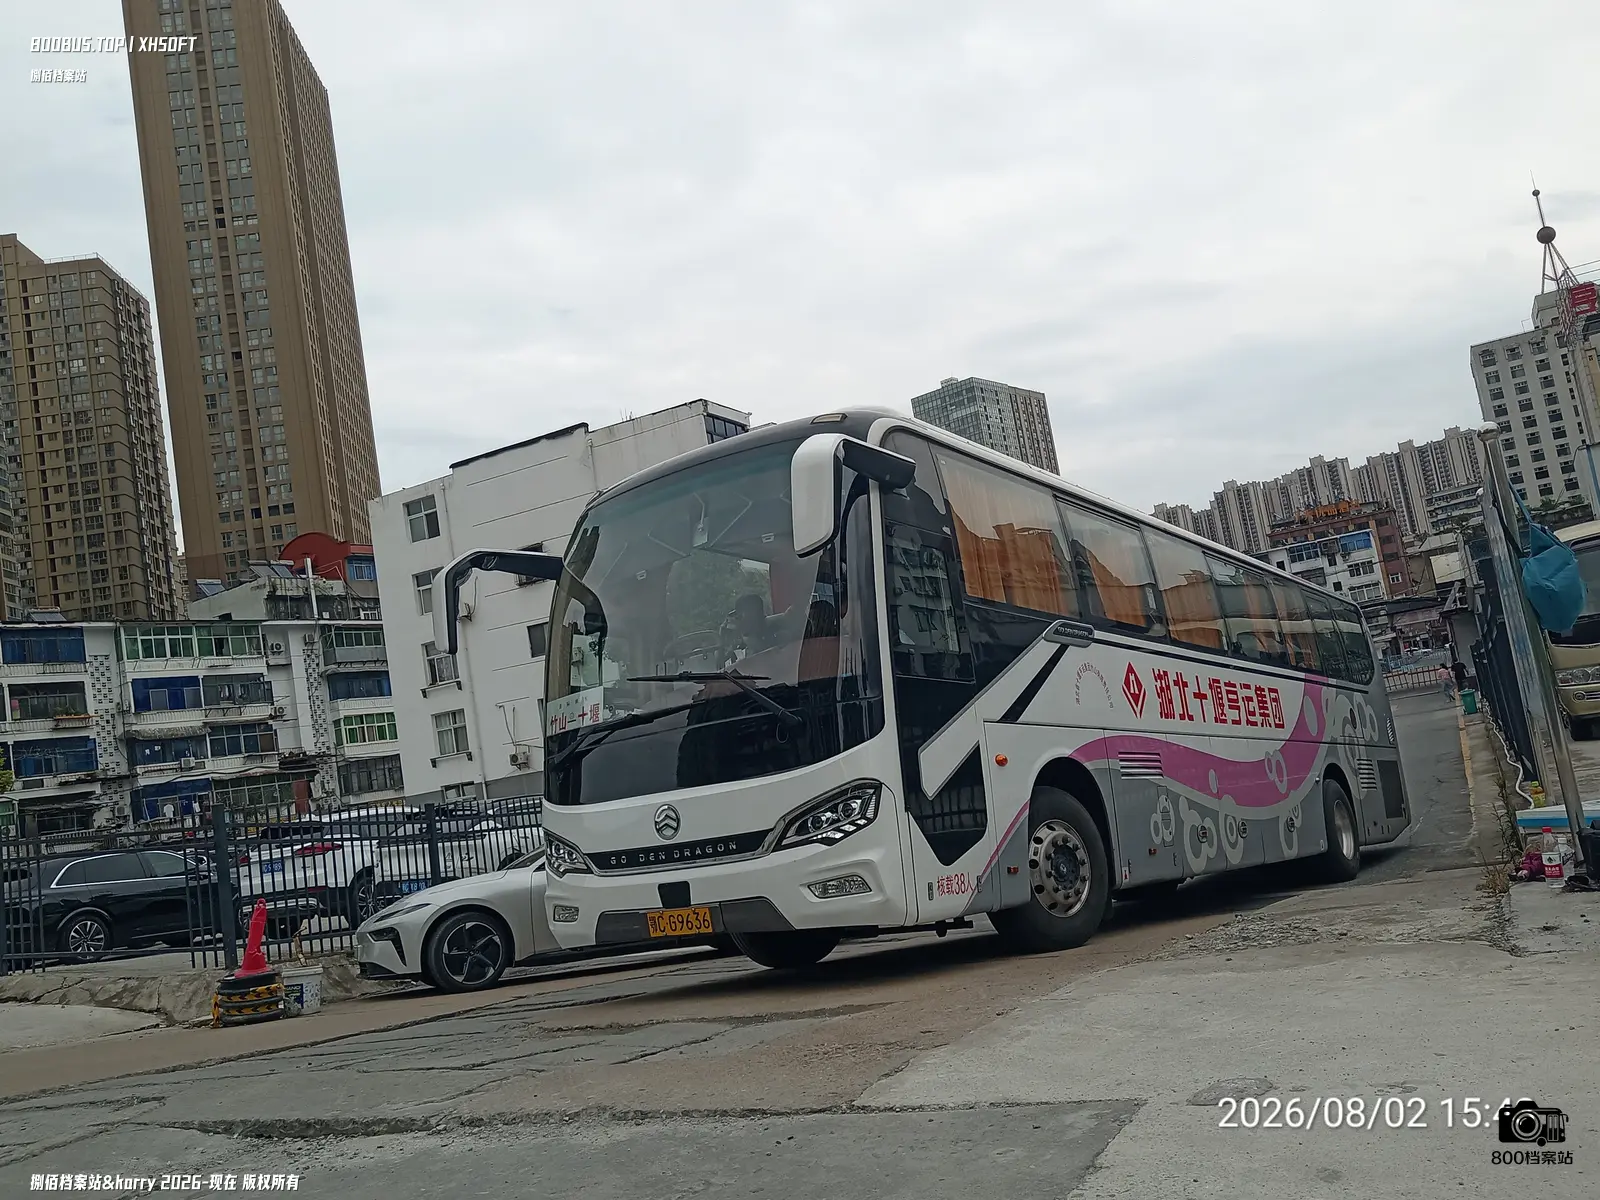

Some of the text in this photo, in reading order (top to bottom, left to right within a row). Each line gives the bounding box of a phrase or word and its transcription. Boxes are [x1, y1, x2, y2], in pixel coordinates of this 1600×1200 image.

[1151, 667, 1285, 729] 湖北十堰亨运集团
[673, 841, 737, 858] DRAGON
[937, 872, 974, 896] 核载38人
